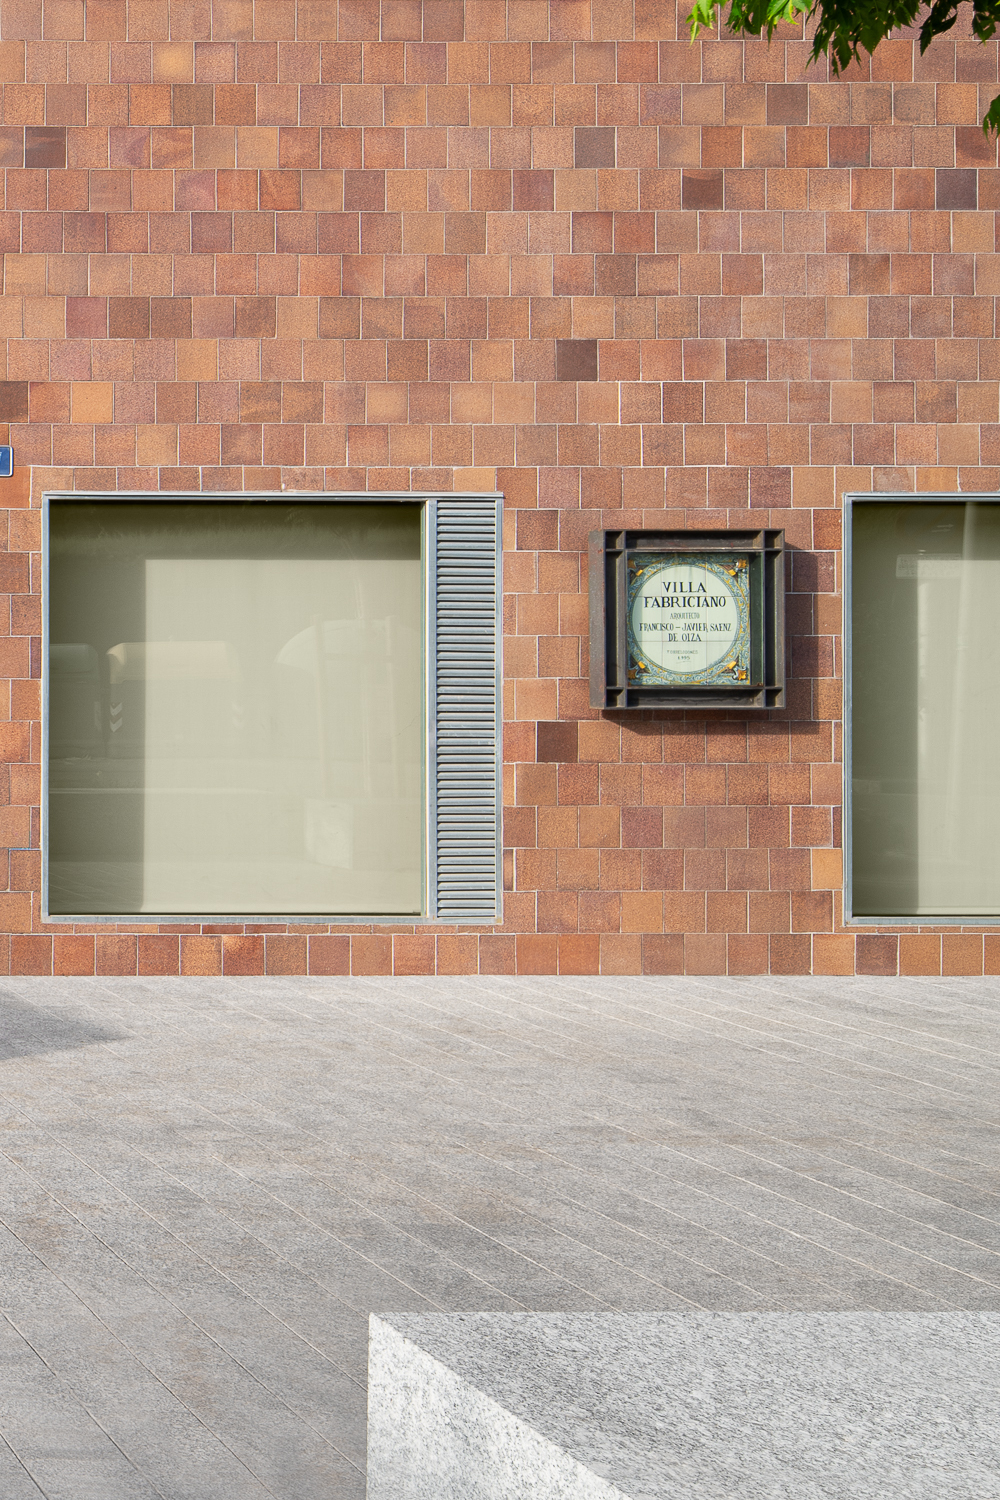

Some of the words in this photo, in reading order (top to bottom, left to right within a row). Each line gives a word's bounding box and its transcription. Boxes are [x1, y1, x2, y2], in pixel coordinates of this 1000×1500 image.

[662, 582, 706, 593] VILLA
[644, 596, 726, 608] FABRICIANO
[669, 612, 700, 620] ARQUITECTO
[639, 622, 674, 632] FRANCISCO
[681, 622, 708, 632] JAVIER
[709, 622, 732, 632] SAENZ
[668, 633, 678, 642] DE
[681, 633, 702, 642] OIZA
